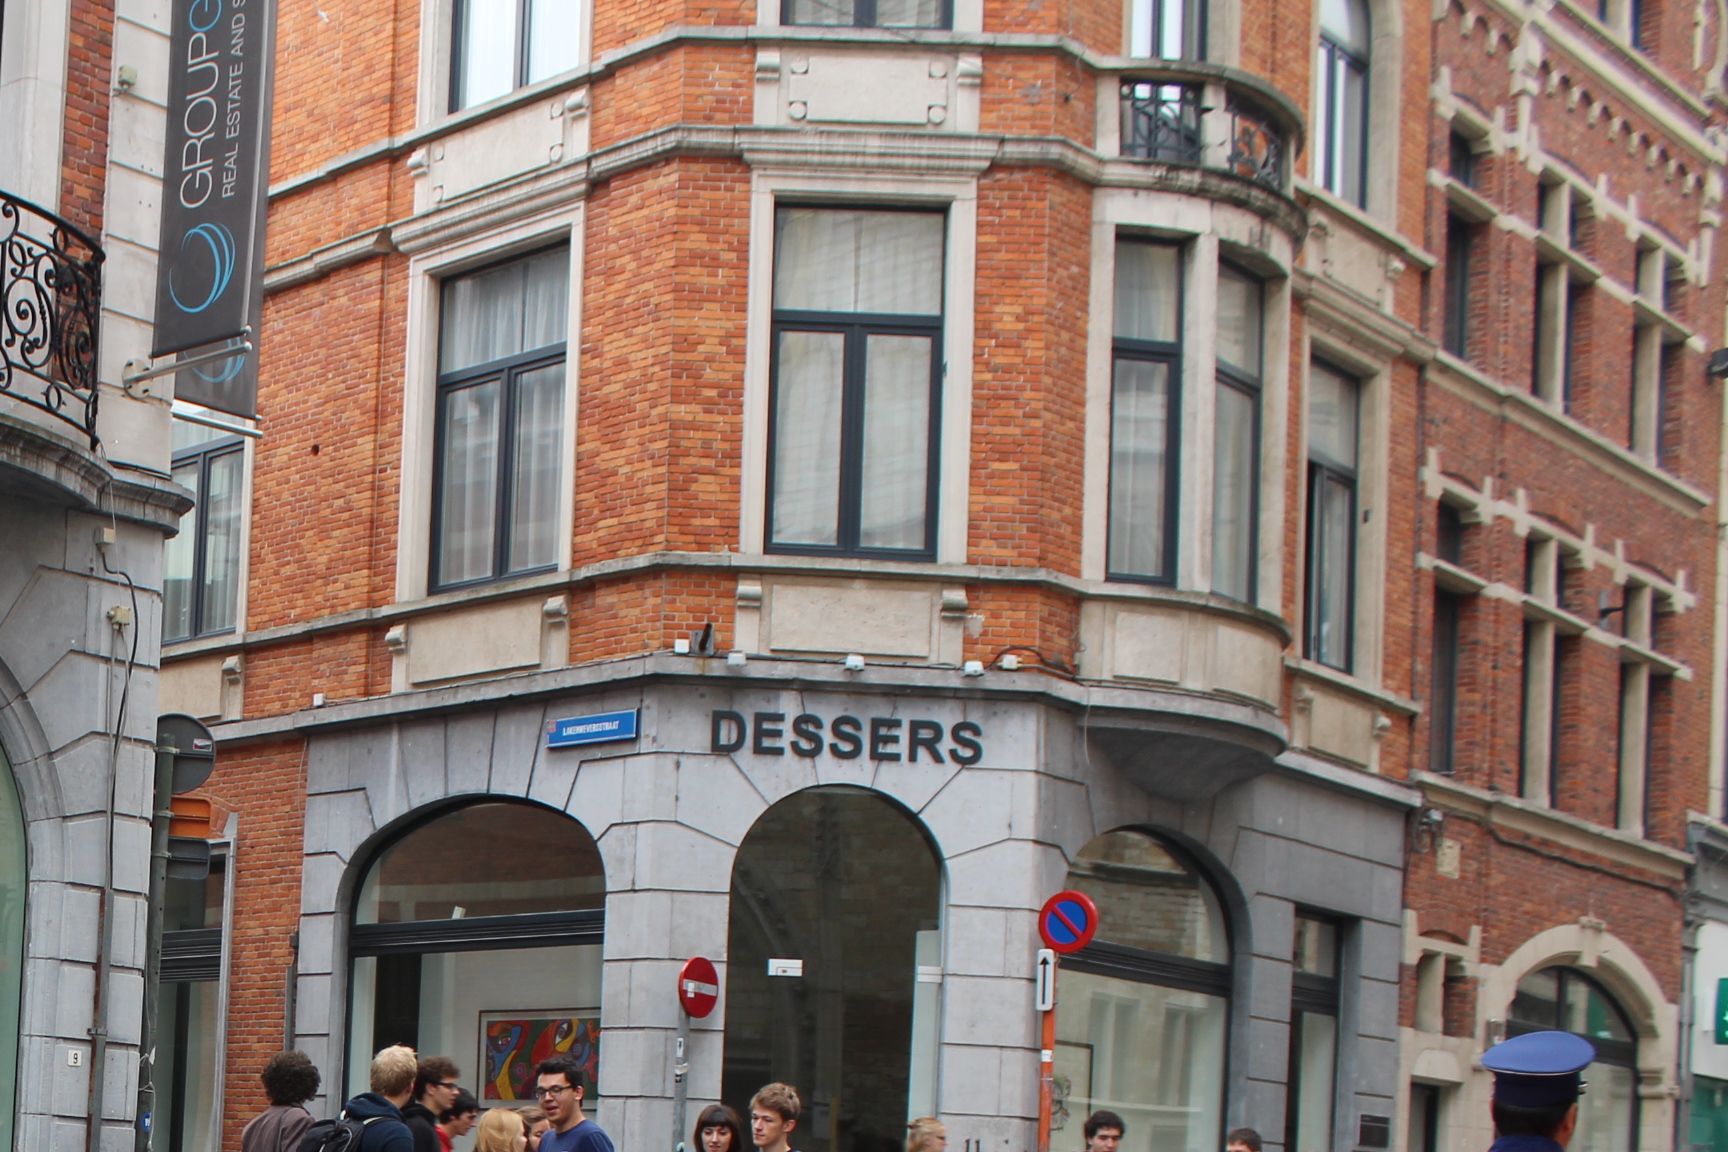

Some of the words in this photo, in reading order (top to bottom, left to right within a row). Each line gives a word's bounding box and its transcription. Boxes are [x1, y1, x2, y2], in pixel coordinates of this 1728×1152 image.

[230, 13, 246, 57] AND
[225, 62, 243, 140] ESTATE
[222, 142, 239, 199] REAL
[711, 709, 984, 766] DESSERS
[73, 1053, 78, 1064] 9
